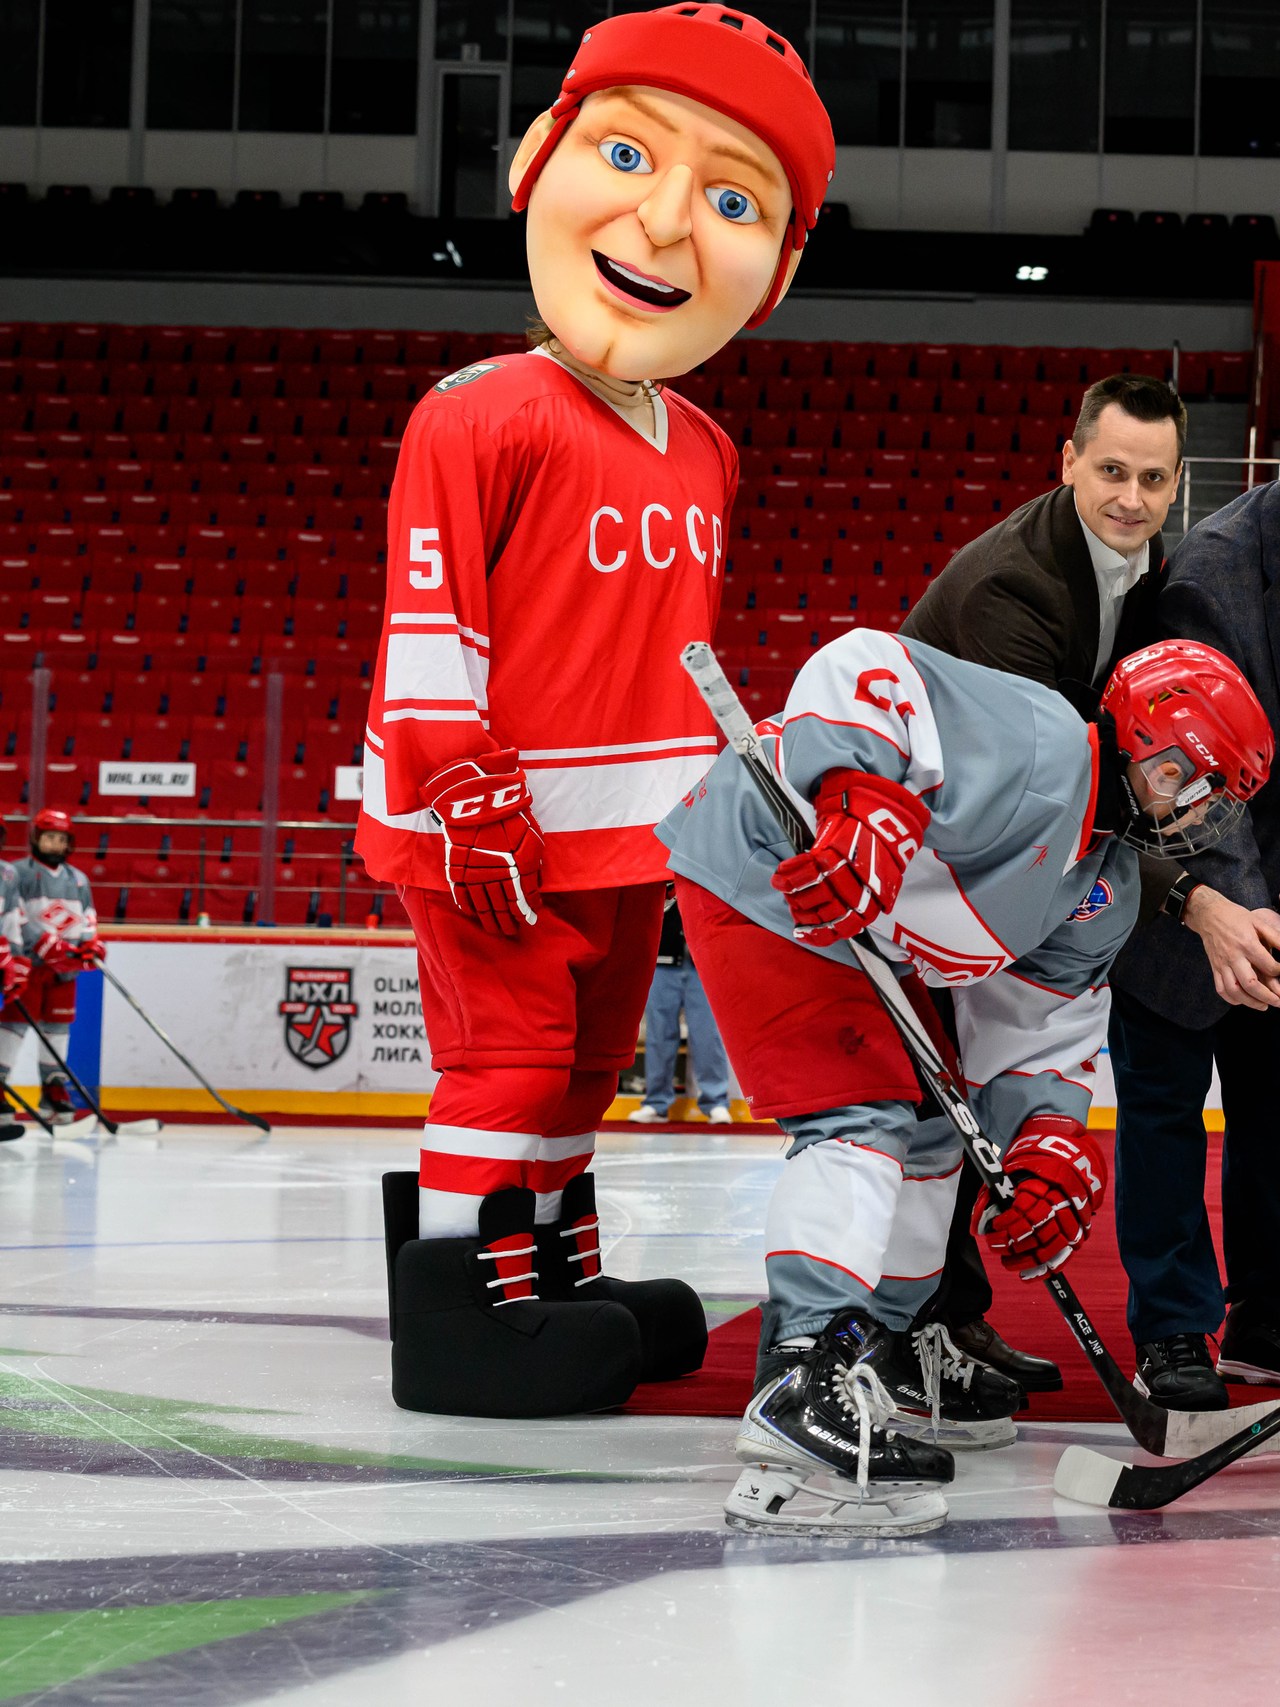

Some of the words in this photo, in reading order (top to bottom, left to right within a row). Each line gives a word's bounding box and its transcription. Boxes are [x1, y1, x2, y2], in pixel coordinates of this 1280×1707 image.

[589, 503, 722, 577] СССР
[409, 528, 443, 590] 5
[1185, 731, 1219, 767] CCM
[450, 783, 531, 819] CC
[867, 808, 919, 866] CC
[289, 983, 349, 1001] МХЛ
[373, 1001, 422, 1016] МОЛ
[372, 1024, 426, 1039] ХОКК
[372, 1047, 422, 1063] ЛИГА
[1006, 1134, 1102, 1194] CCM
[1073, 1312, 1092, 1336] ACE
[1088, 1339, 1104, 1356] JNR
[897, 1385, 944, 1406] BAUE
